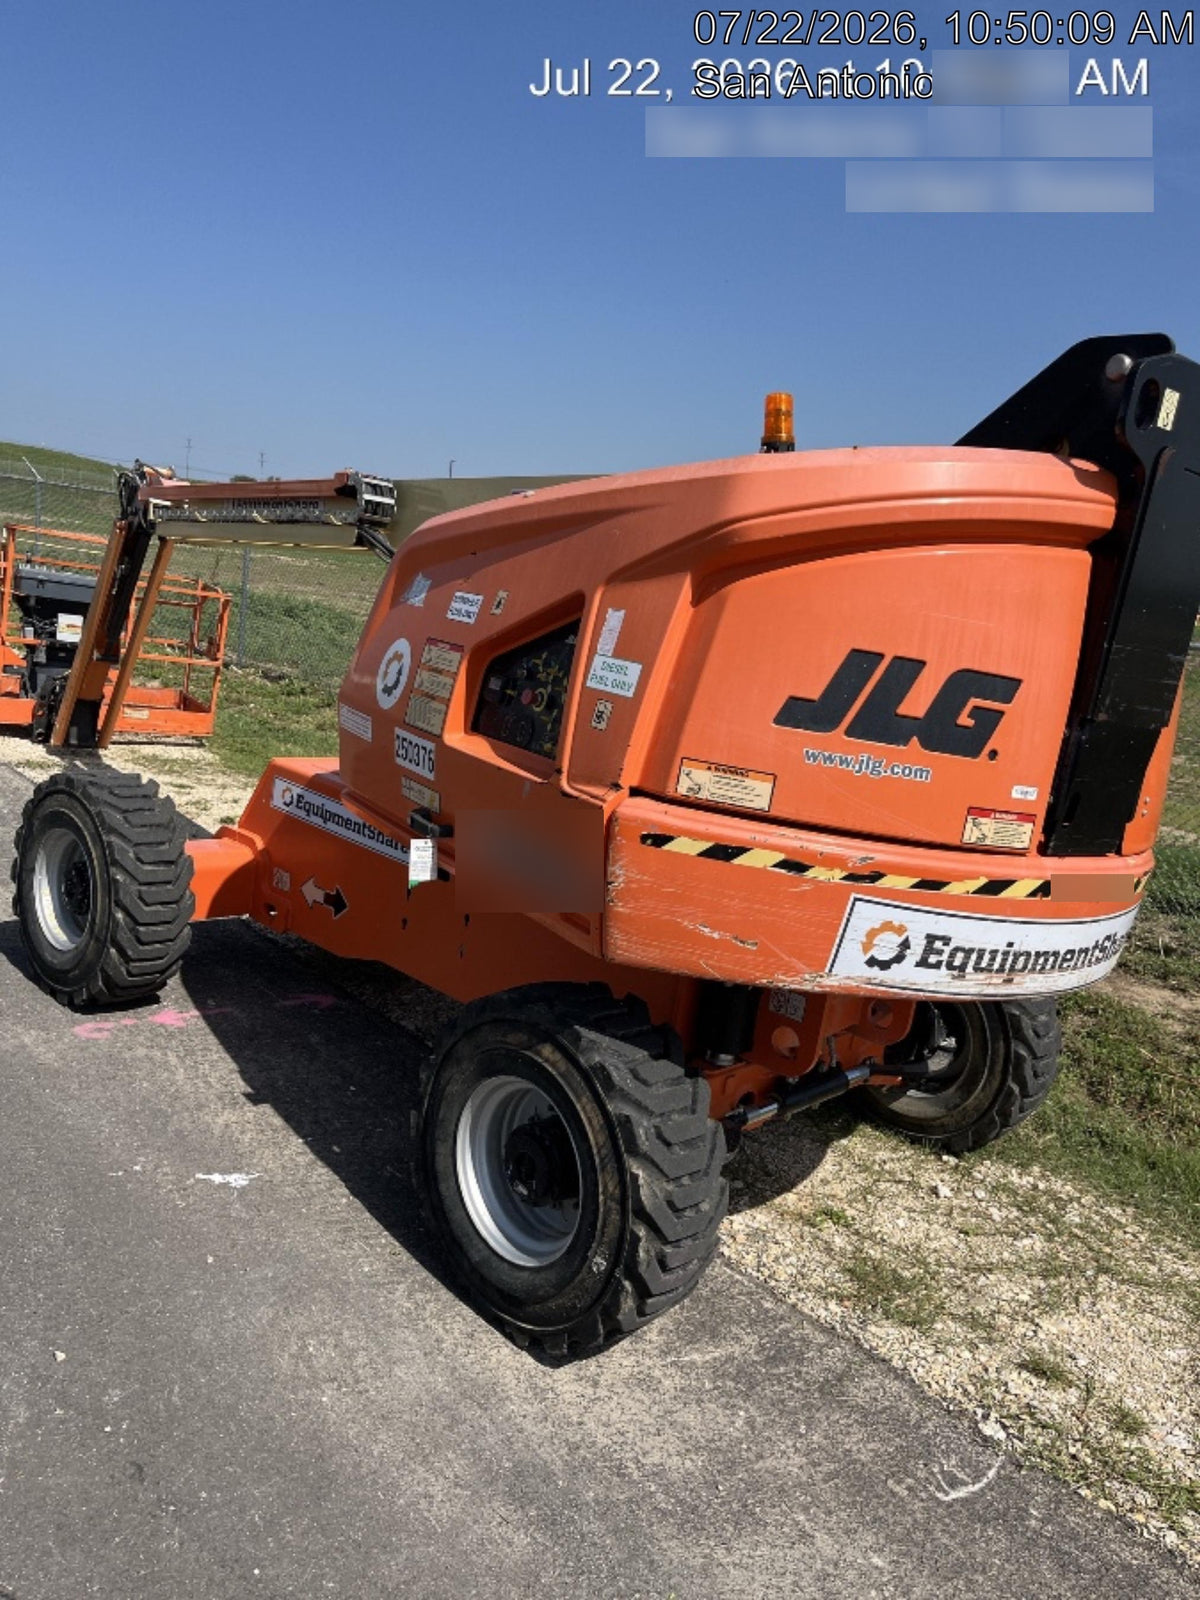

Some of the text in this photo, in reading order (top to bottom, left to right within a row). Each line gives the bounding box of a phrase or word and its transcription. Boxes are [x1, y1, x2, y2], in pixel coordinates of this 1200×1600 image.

[600, 661, 629, 676] DIESEL
[611, 678, 634, 692] ONLY
[395, 734, 435, 774] 250376
[803, 749, 931, 782] www.jlg.com
